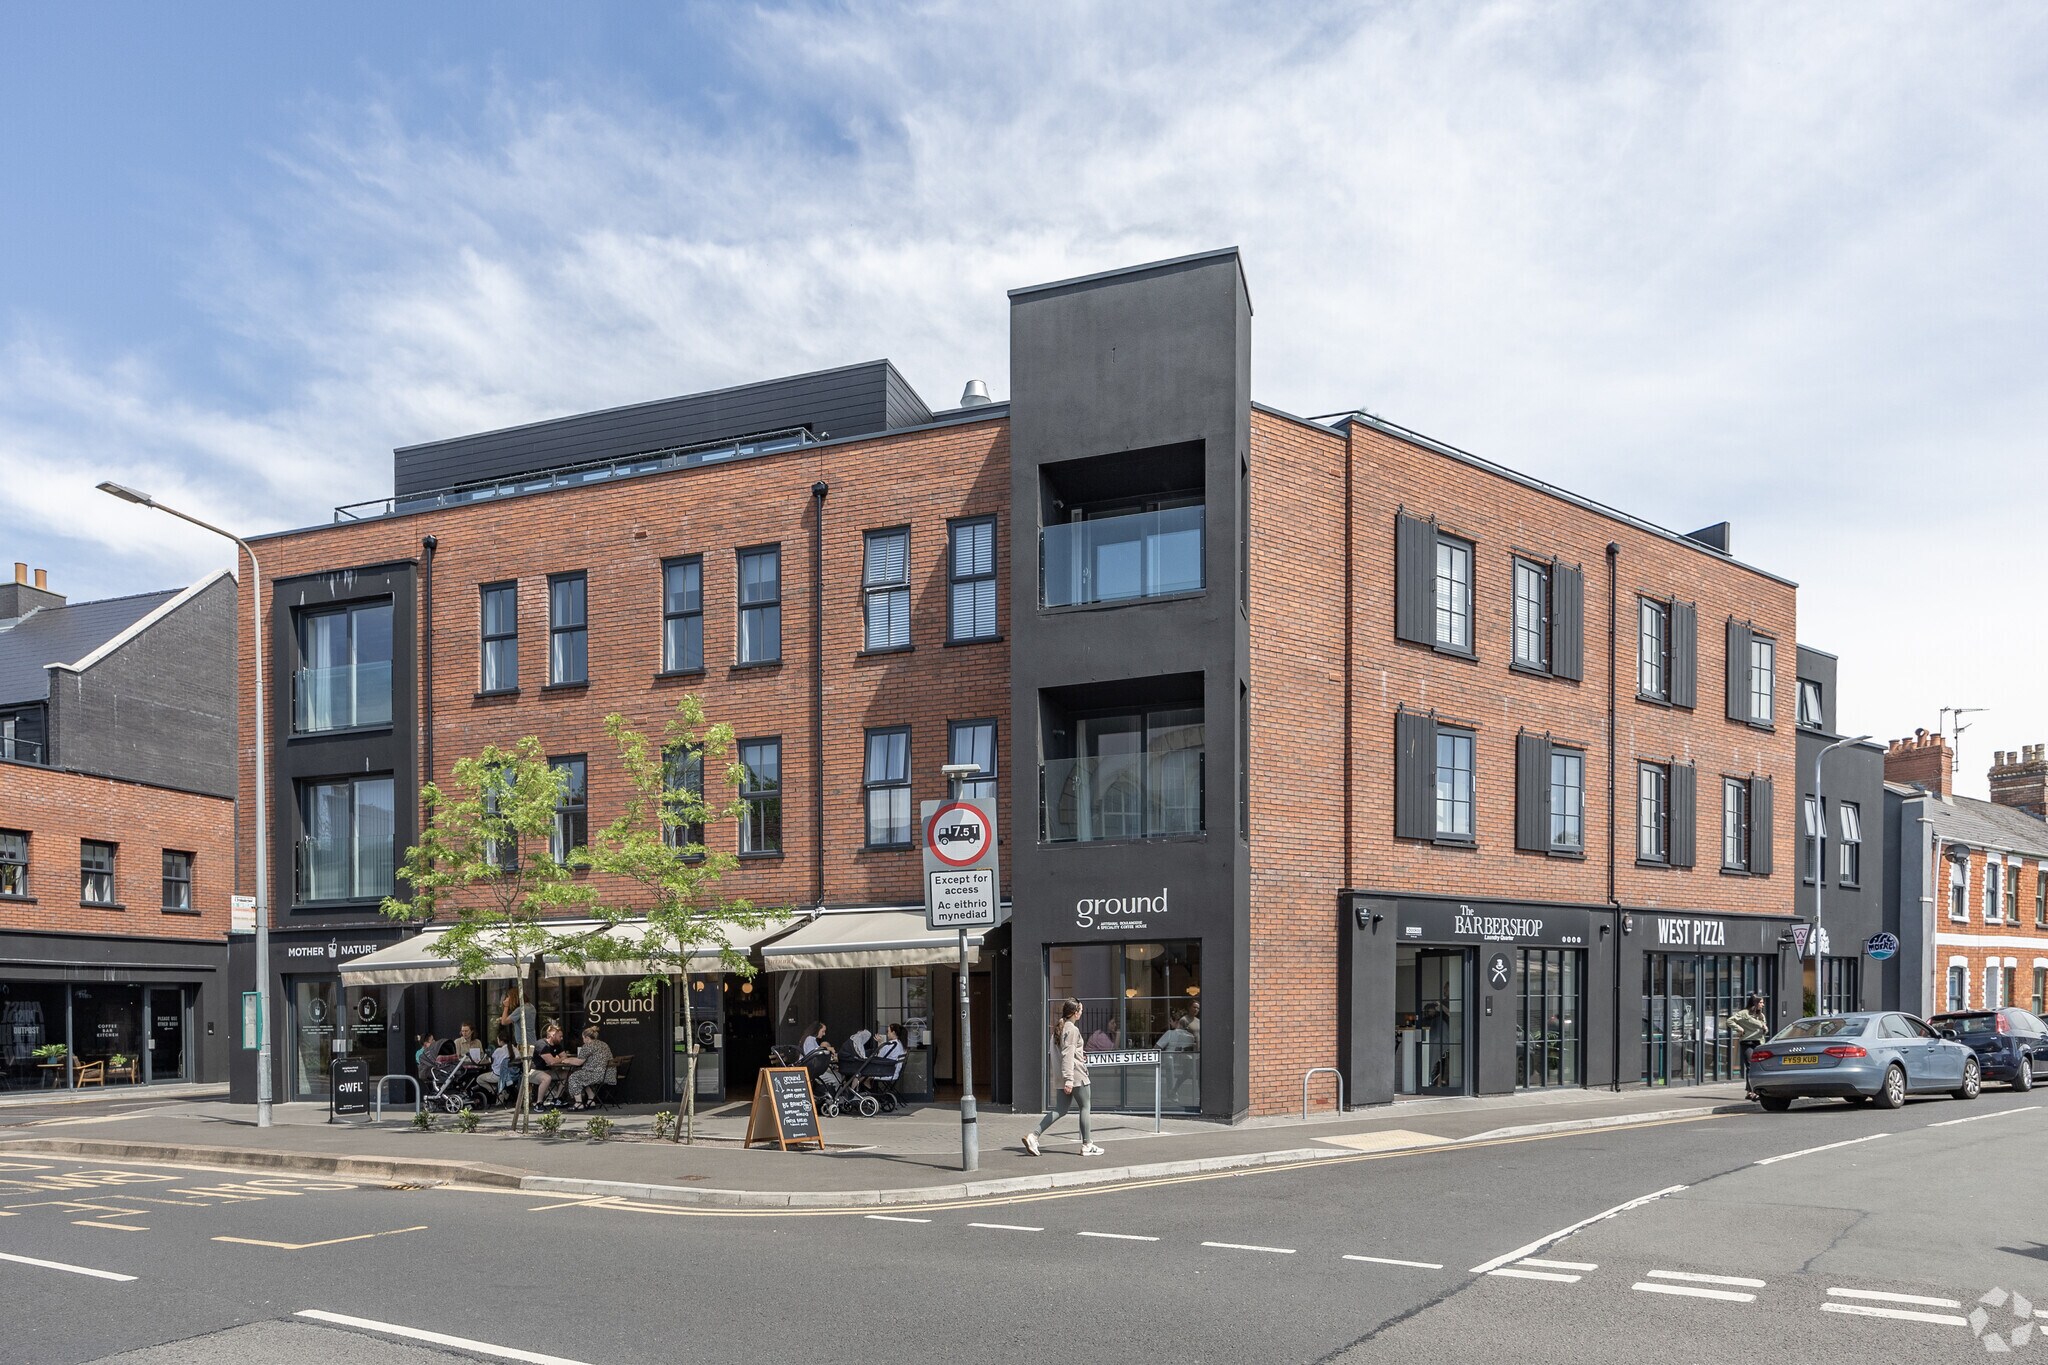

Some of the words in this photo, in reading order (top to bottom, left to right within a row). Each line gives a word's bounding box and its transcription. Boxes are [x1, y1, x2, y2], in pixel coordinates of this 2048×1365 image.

[935, 876, 970, 885] Except
[973, 874, 988, 883] for
[945, 886, 979, 895] access
[938, 901, 951, 910] Ac
[954, 899, 988, 909] eithrio
[1076, 888, 1168, 928] ground
[939, 910, 987, 921] mynediad
[1460, 905, 1475, 916] The
[1454, 915, 1543, 937] BARBERSHOP
[1658, 918, 1691, 945] WEST
[1693, 920, 1725, 946] PIZZA
[288, 947, 324, 957] MOTHER
[341, 944, 377, 955] NATURE
[588, 990, 655, 1023] ground
[13, 1026, 40, 1035] OUTPOST
[704, 1025, 713, 1041] 3
[1085, 1054, 1121, 1064] LYNNE
[1124, 1052, 1158, 1062] STREET
[1783, 1056, 1802, 1064] FY59
